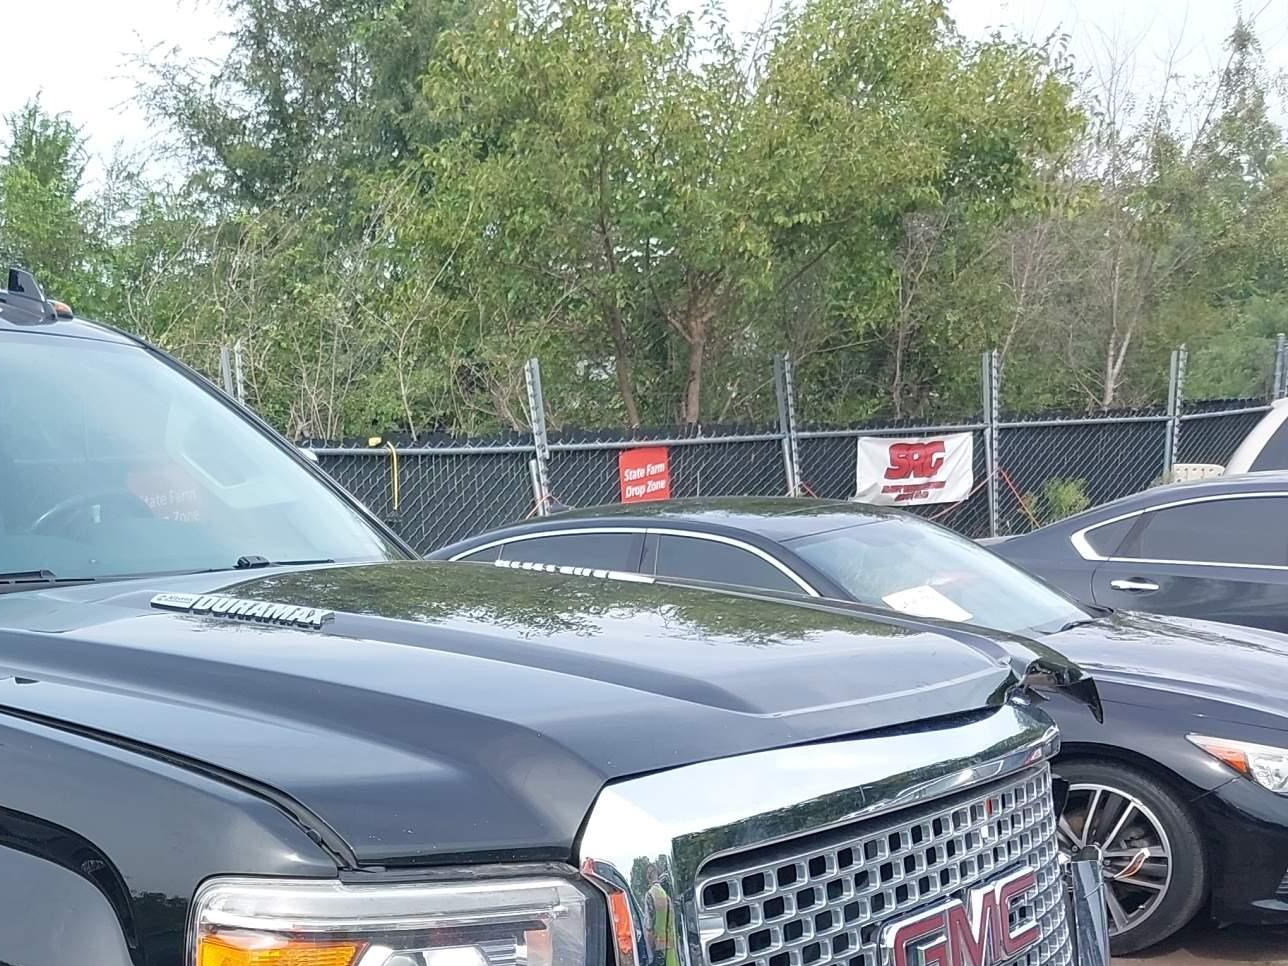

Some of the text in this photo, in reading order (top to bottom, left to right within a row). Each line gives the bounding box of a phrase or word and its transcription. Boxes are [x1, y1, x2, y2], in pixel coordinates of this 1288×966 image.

[624, 463, 665, 482] State Farm
[625, 480, 666, 499] Drop Zone
[192, 597, 331, 629] DURAMAX
